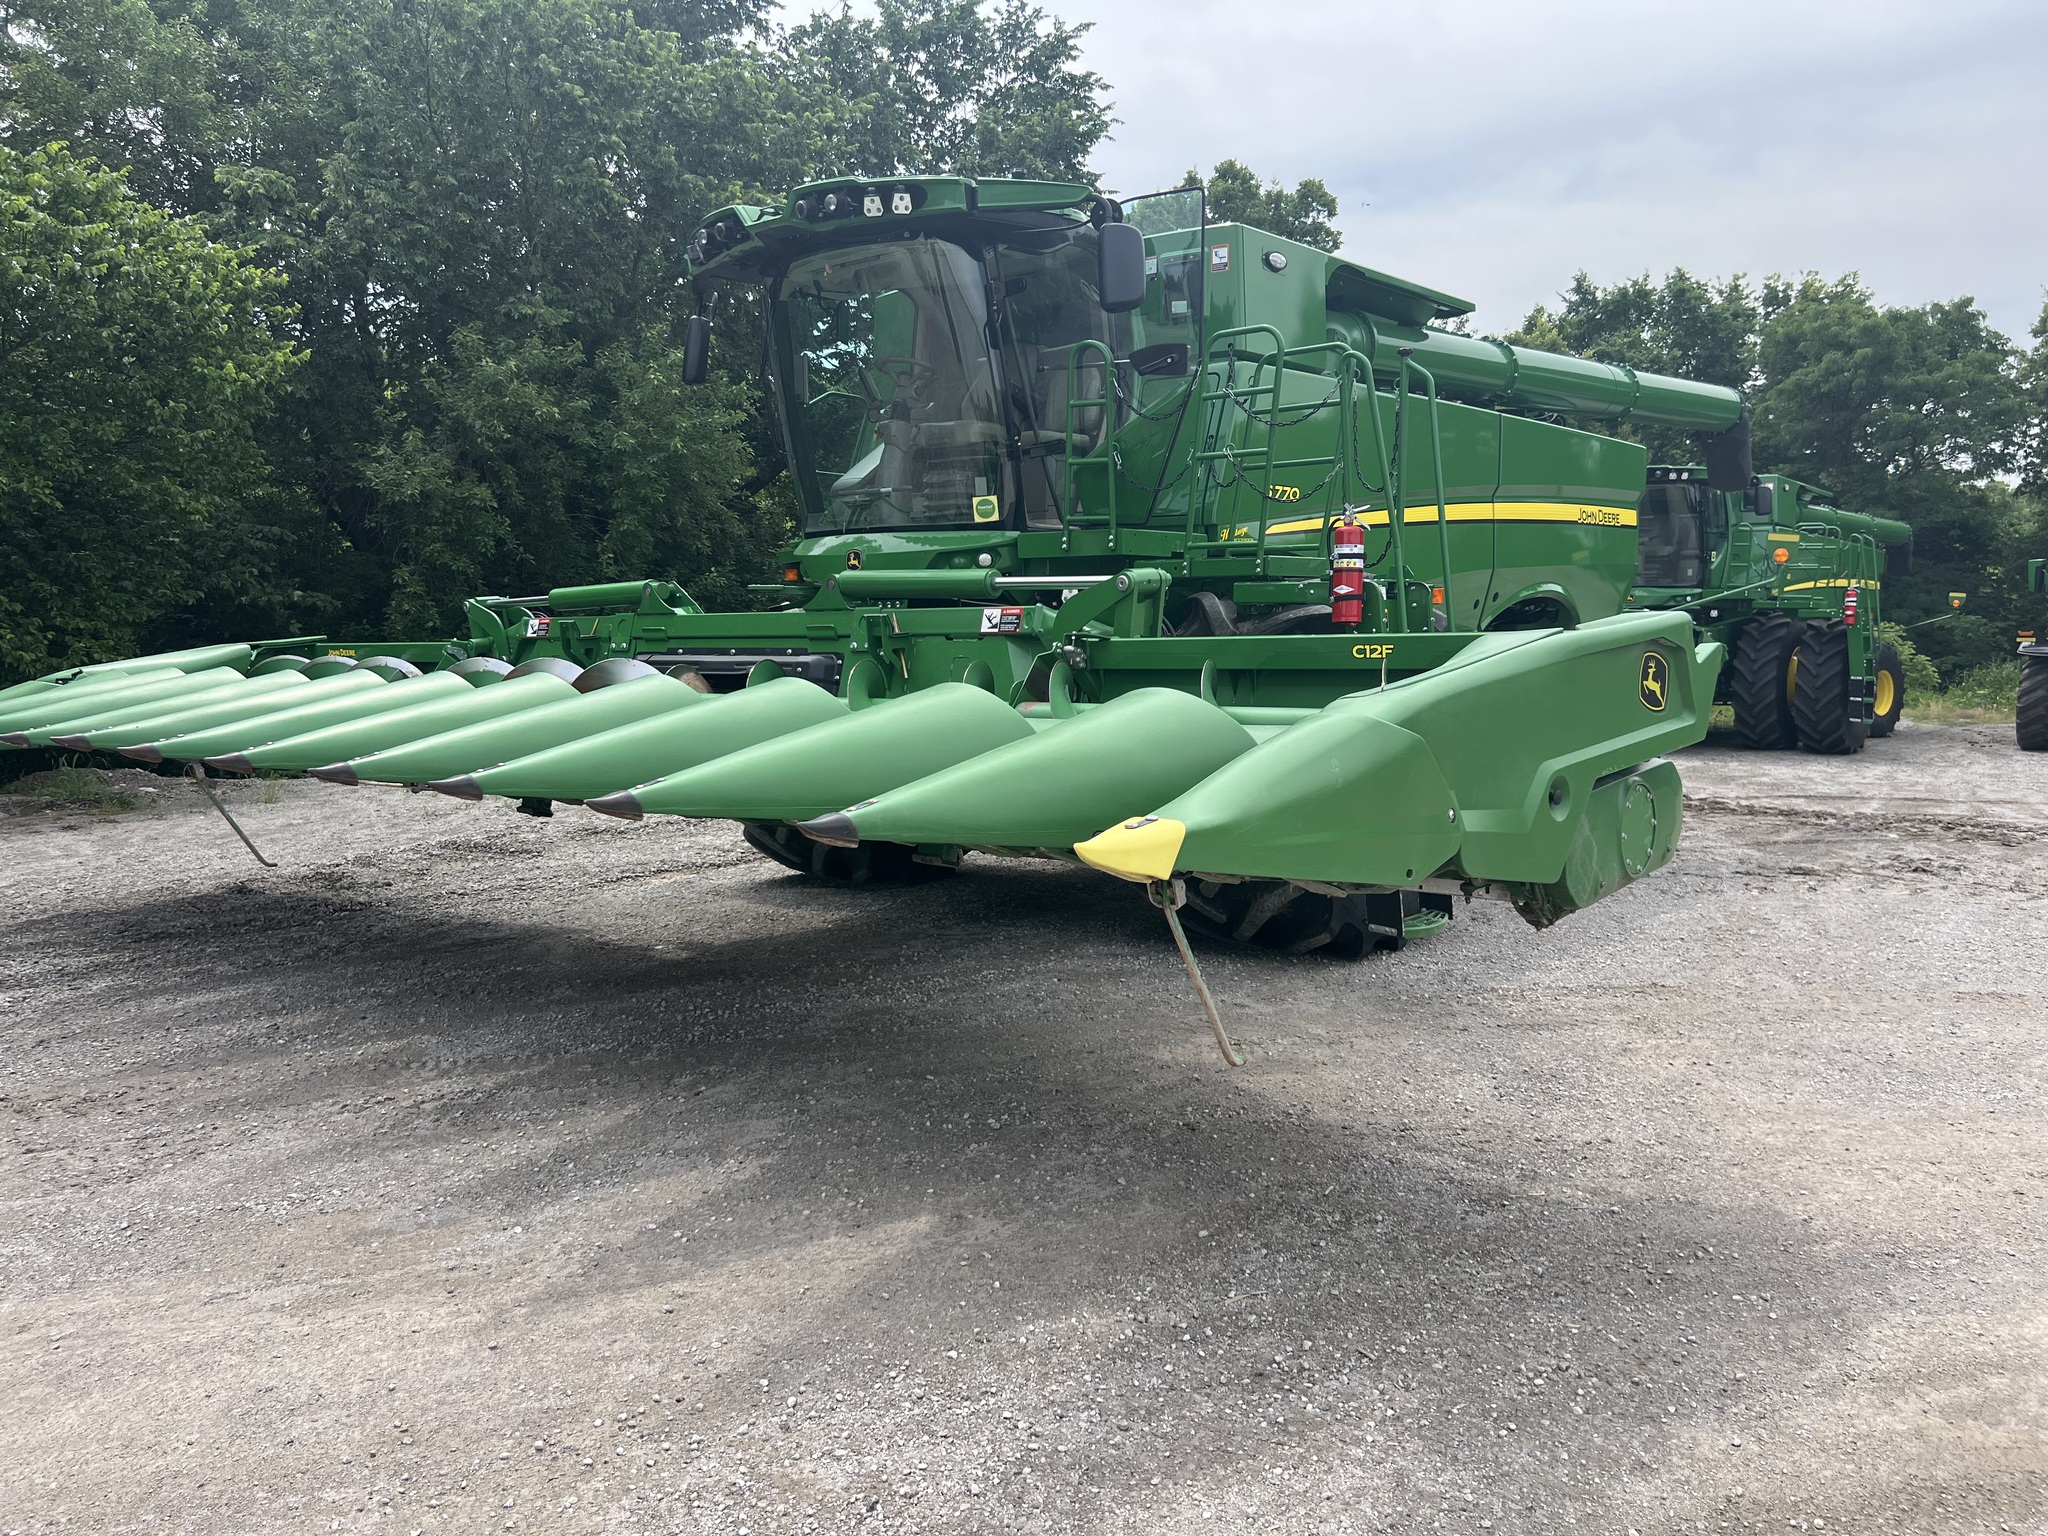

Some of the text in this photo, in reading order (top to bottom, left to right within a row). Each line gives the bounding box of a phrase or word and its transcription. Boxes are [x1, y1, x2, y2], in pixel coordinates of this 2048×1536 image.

[1577, 507, 1621, 525] JOHN DEERE
[328, 649, 356, 657] JOHN DEERE
[1352, 644, 1395, 659] C12F
